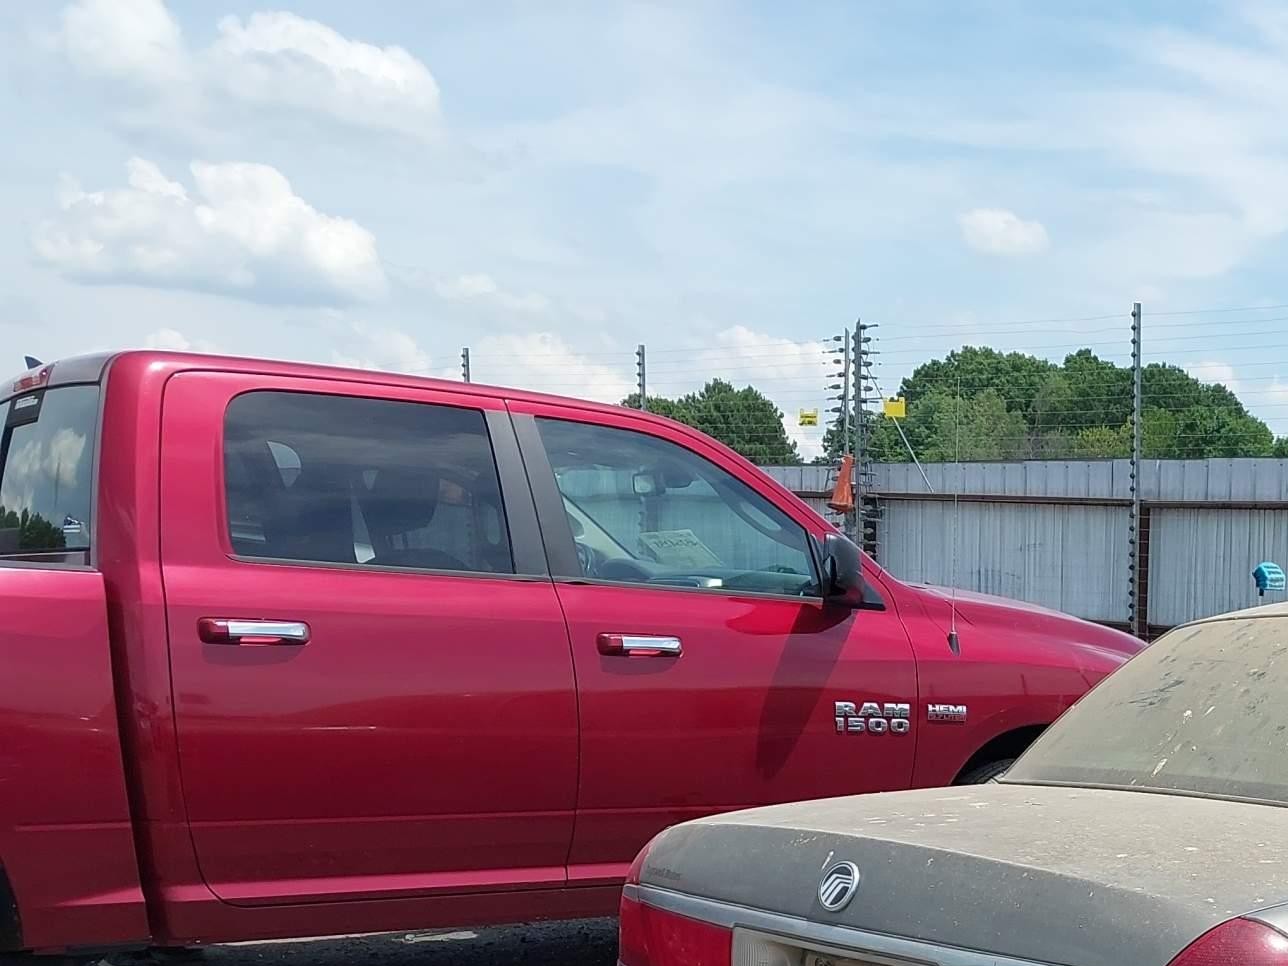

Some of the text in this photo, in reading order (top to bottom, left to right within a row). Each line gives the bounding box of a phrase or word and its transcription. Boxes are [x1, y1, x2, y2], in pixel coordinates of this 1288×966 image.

[834, 701, 910, 718] RAM
[927, 703, 967, 714] HEMI
[835, 717, 910, 733] 1500
